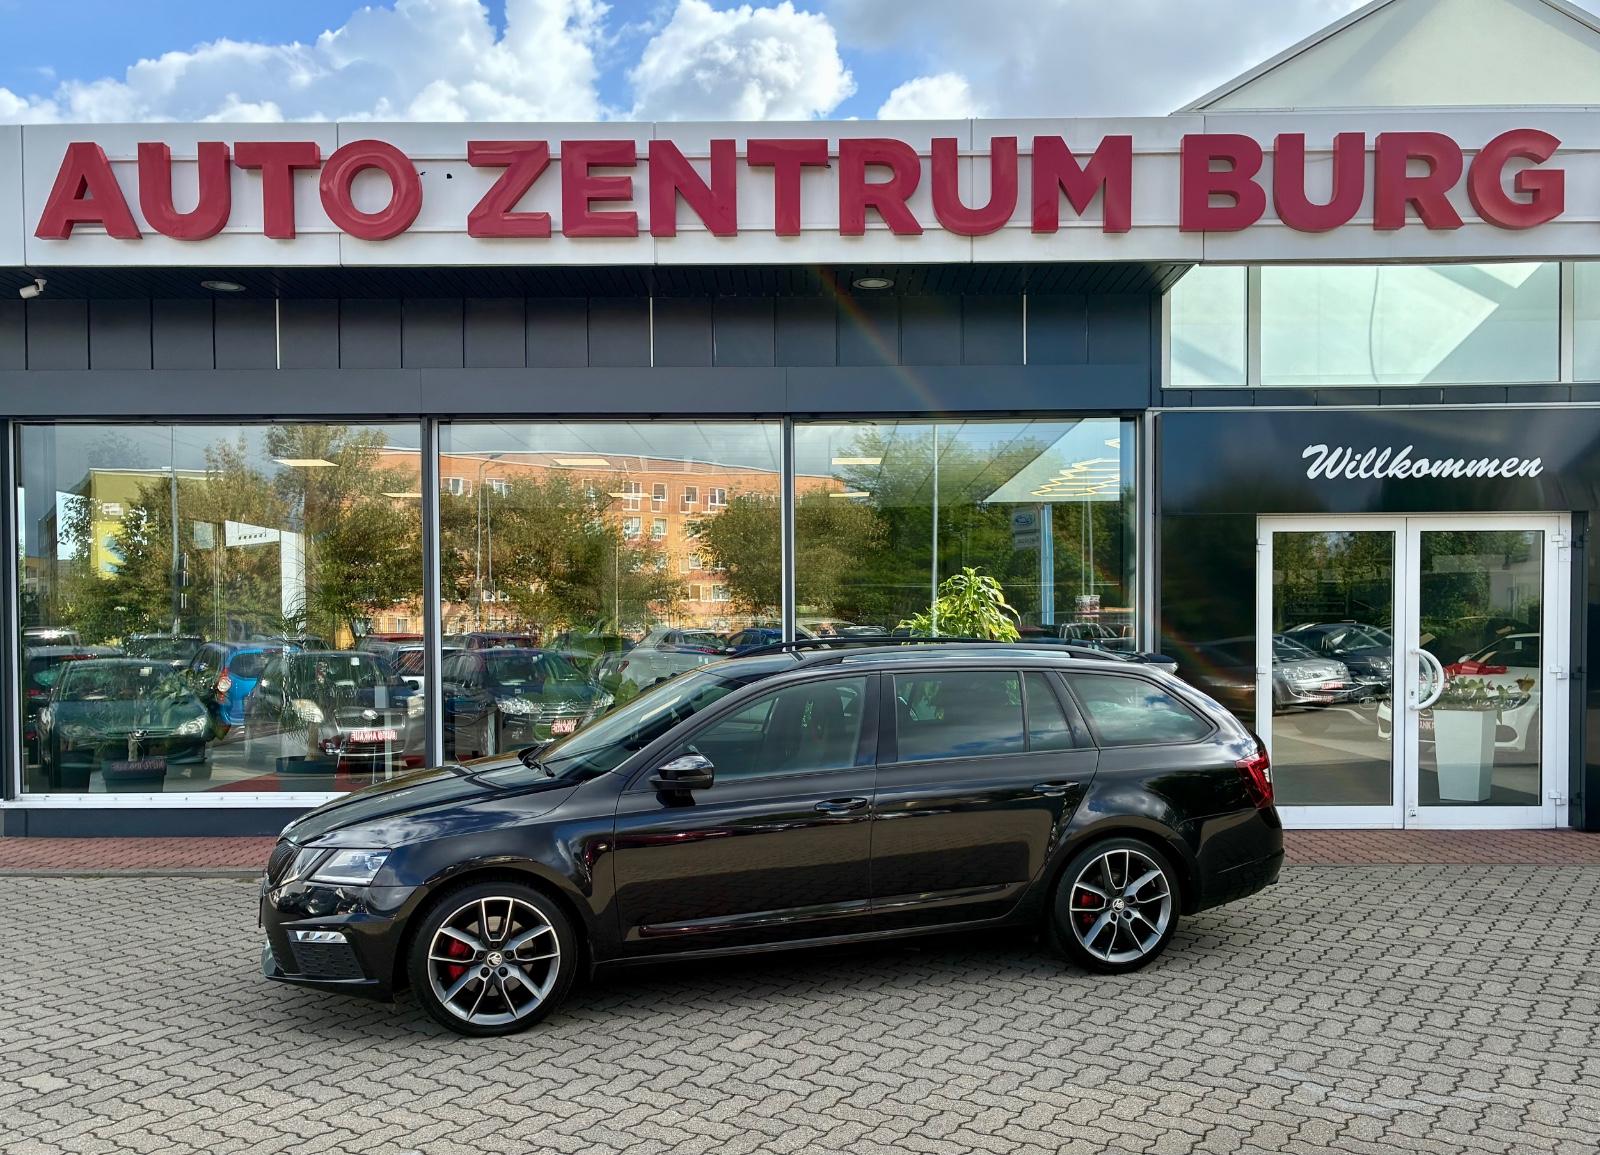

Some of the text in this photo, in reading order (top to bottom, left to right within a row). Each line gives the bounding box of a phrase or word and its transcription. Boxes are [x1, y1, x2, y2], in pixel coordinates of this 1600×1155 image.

[34, 128, 1565, 241] AUTO ZENTRUM BURG
[1301, 443, 1544, 480] Willkommen
